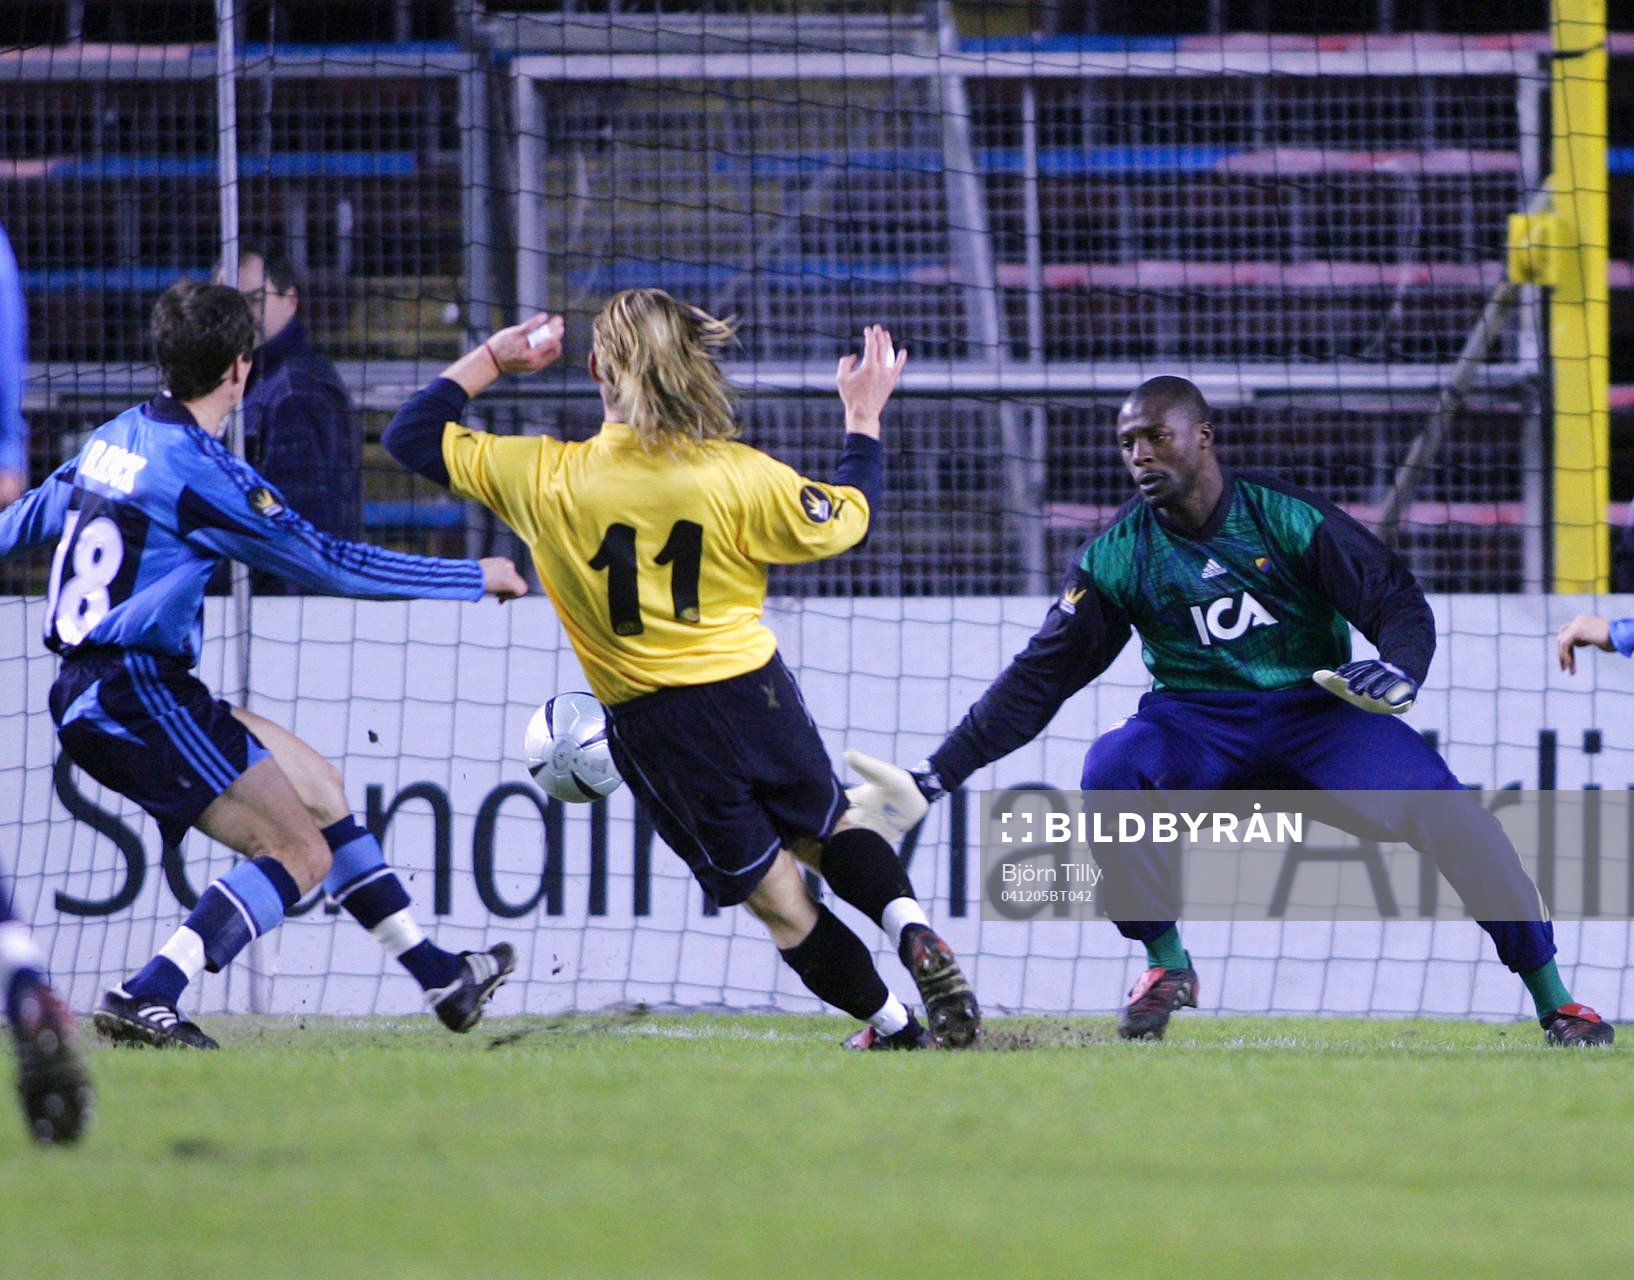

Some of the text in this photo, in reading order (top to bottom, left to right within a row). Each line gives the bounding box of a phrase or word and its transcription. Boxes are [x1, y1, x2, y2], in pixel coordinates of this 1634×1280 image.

[44, 509, 124, 646] 18
[588, 519, 704, 637] 11
[1191, 591, 1279, 646] ICA
